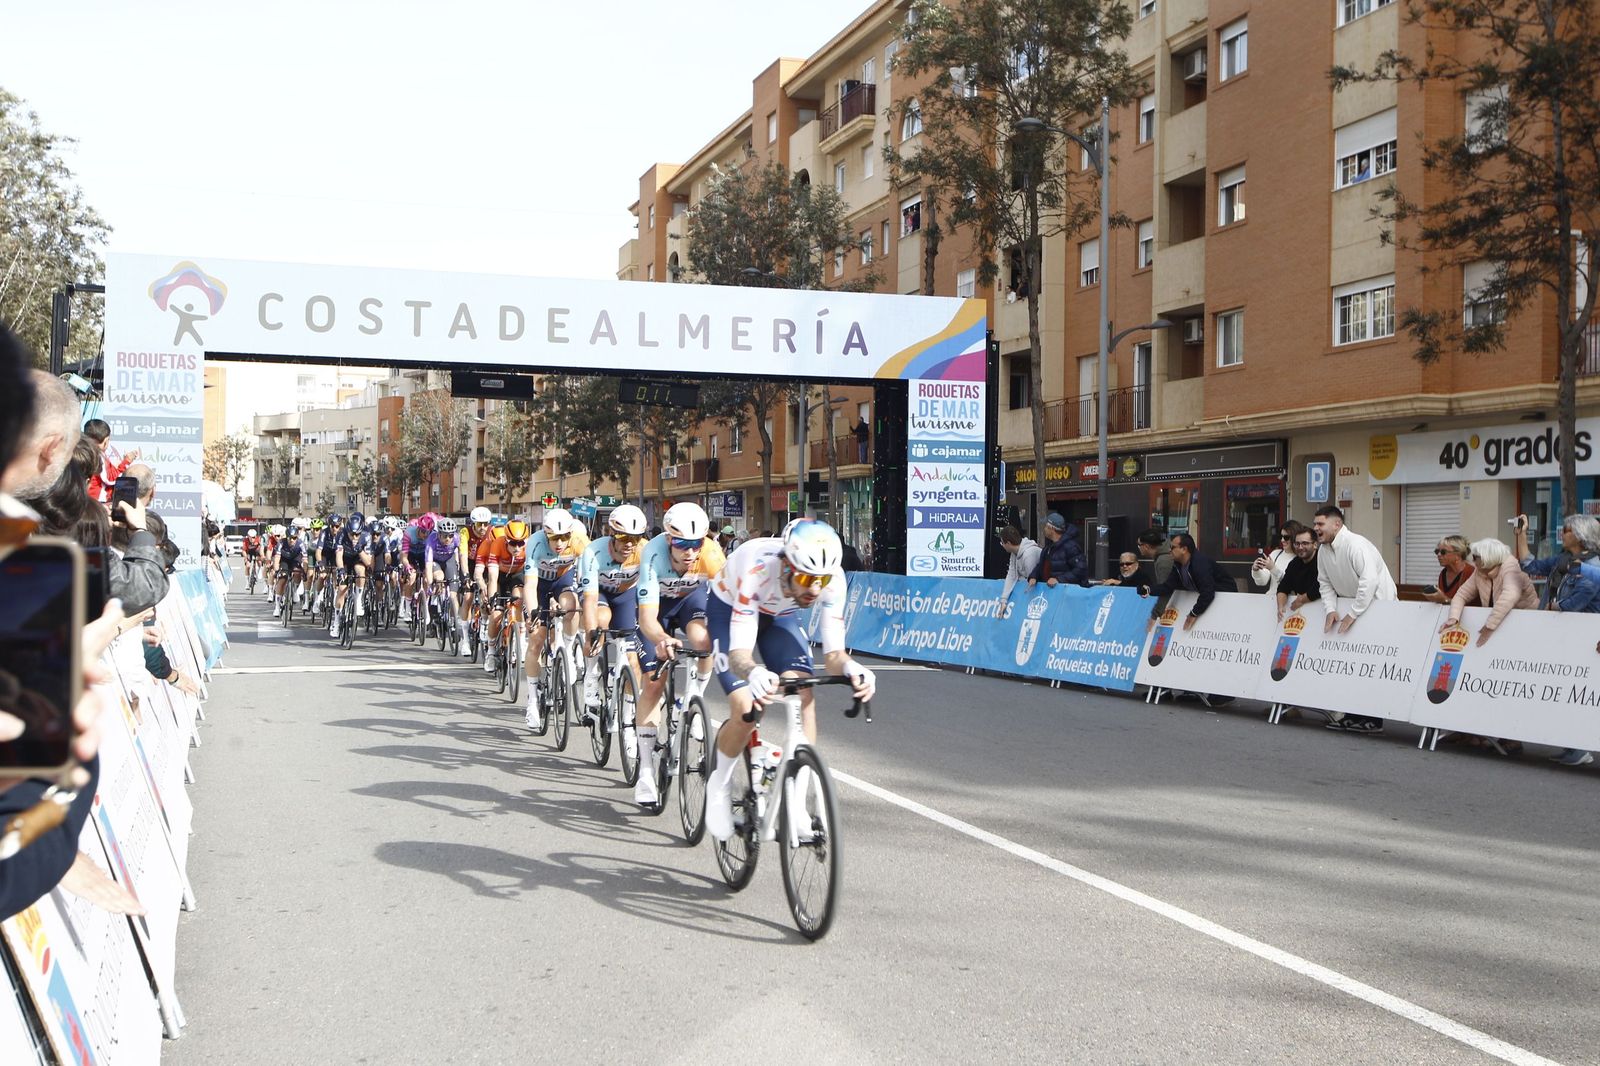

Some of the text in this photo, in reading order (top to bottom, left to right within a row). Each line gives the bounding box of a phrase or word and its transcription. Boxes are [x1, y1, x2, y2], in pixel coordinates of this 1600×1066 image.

[117, 352, 197, 370] ROQUETAS
[117, 370, 196, 392] DE MAR
[106, 385, 192, 404] turismo
[919, 383, 980, 399] ROQUETAS
[919, 399, 979, 419] DE MAR
[133, 422, 200, 437] cajamar
[910, 413, 976, 430] turismo
[931, 445, 982, 459] cajamar
[911, 466, 982, 482] Andalucía
[912, 489, 977, 503] syngenta
[941, 556, 976, 564] Smurfit
[941, 564, 981, 572] Westrock
[932, 592, 951, 614] de
[892, 623, 937, 653] Tiempo
[936, 626, 973, 652] Libre
[1189, 630, 1241, 642] AYUNTAMIENTO
[1123, 640, 1139, 658] de
[1169, 641, 1218, 662] ROQUETAS
[1318, 640, 1399, 657] AYUNTAMIENTO DE
[1046, 653, 1132, 680] Roquetas de Mar
[1295, 652, 1412, 682] ROQUETAS DE MAR
[1488, 658, 1591, 678] AYUNTAMIENTO DE
[1459, 672, 1537, 699] ROQUETAS
[1541, 685, 1563, 703] DE
